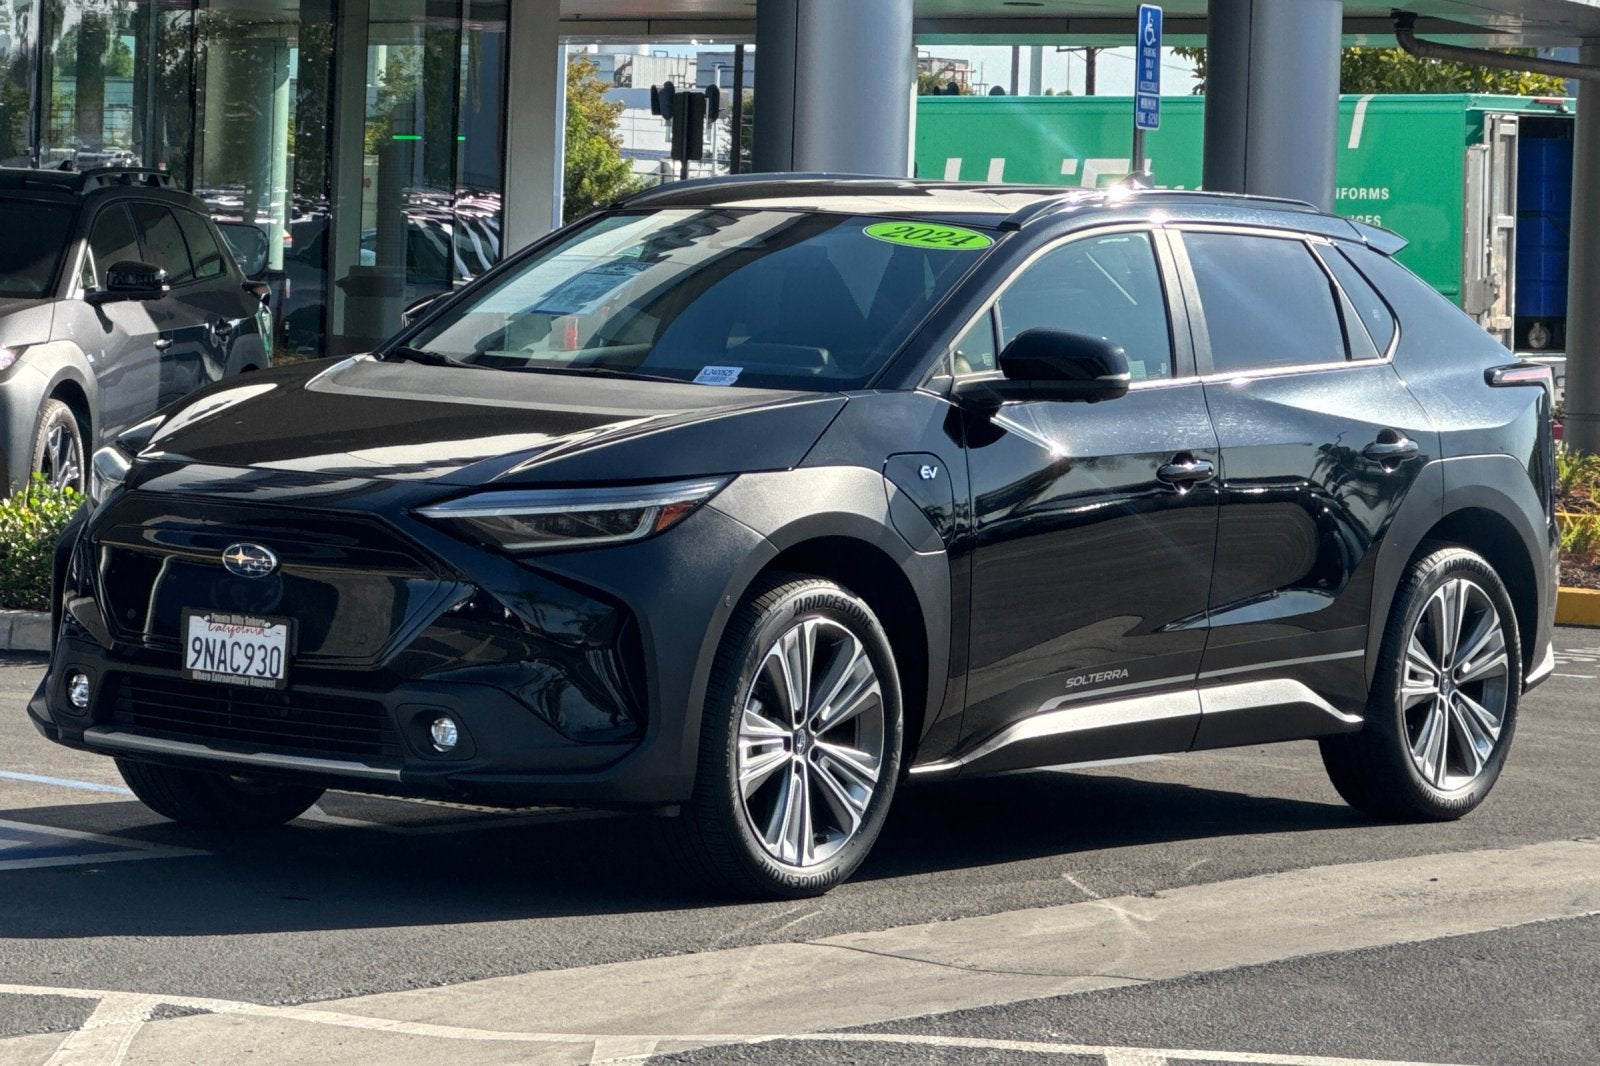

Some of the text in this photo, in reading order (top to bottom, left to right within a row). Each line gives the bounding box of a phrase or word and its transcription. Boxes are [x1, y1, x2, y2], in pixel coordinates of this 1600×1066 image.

[1335, 187, 1390, 200] IFORMS
[880, 226, 978, 246] 2024
[920, 465, 938, 479] EV
[793, 594, 875, 627] BRIDGESTONE
[208, 622, 271, 638] California
[190, 636, 282, 678] 9NAC930
[1065, 668, 1129, 688] SOLTERRA
